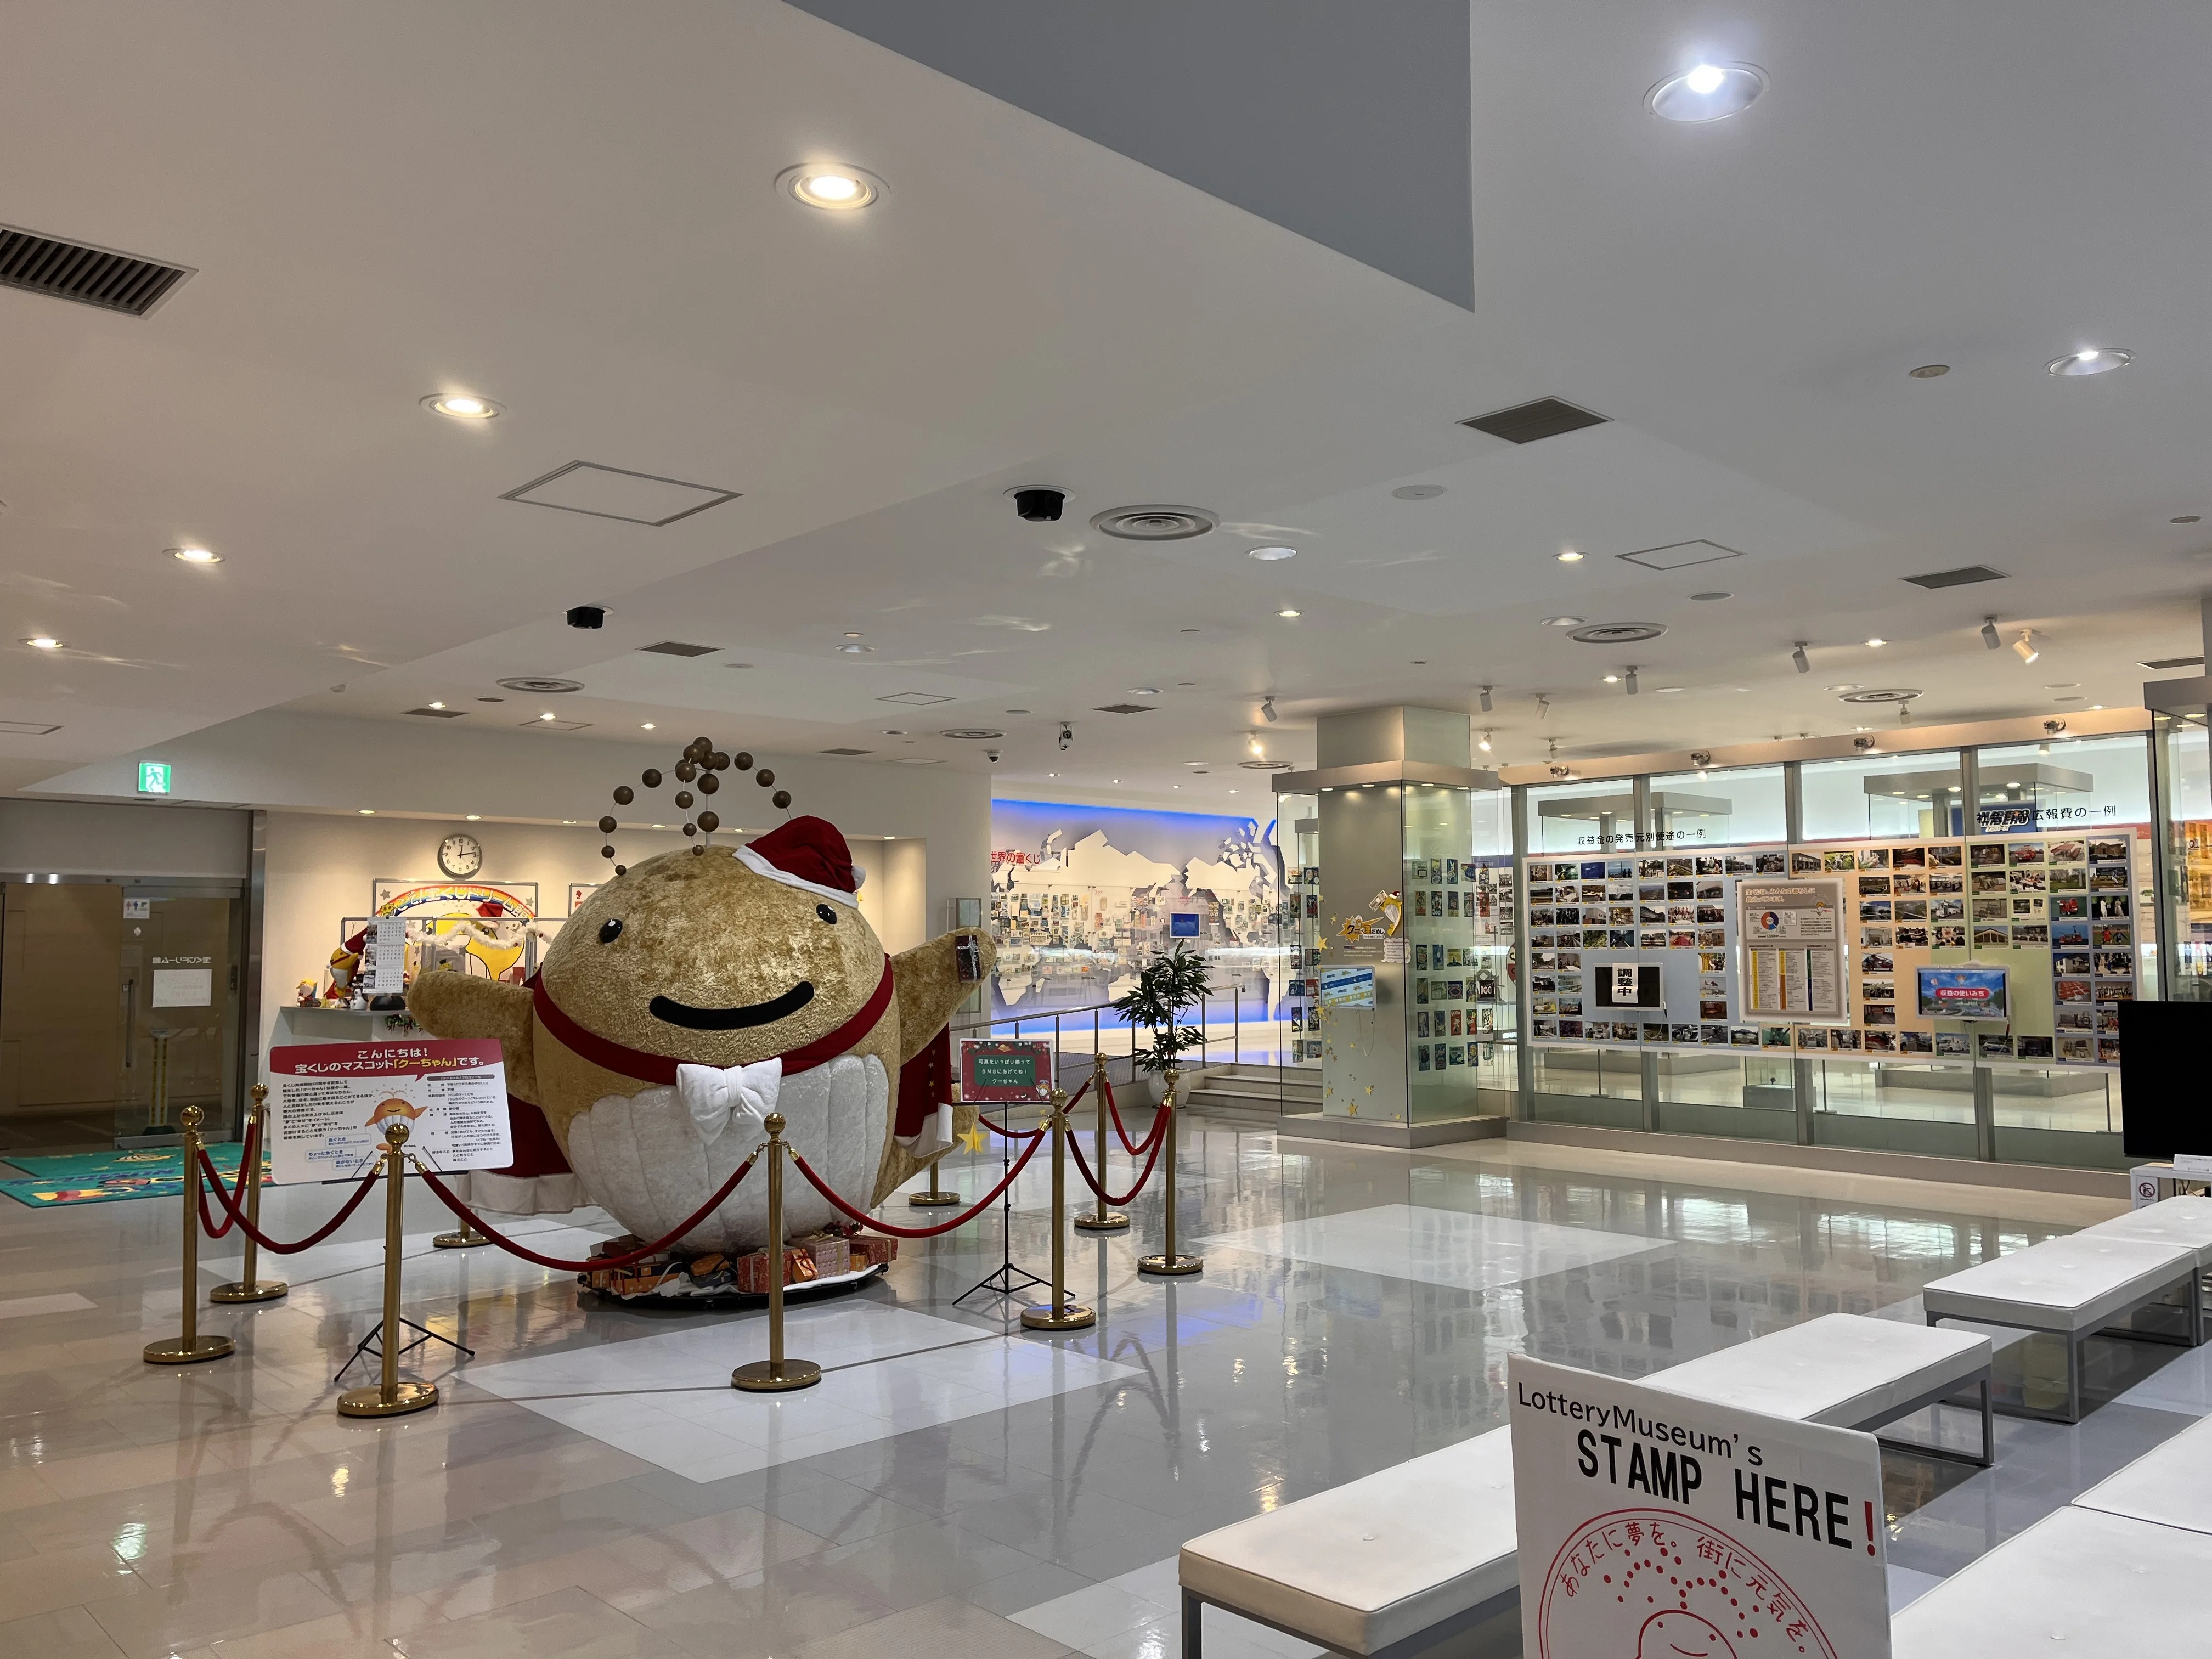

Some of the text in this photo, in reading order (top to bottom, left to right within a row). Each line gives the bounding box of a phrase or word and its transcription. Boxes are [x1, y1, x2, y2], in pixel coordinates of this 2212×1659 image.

[1577, 828, 1706, 845] 収益金の発売元別使途の一例
[991, 851, 1041, 864] 世界の富くじ
[393, 886, 531, 918] こそ！宝くじドリーム館
[1617, 968, 1633, 996] 調整中
[357, 1048, 428, 1059] こんにちは！
[295, 1057, 484, 1074] 宝くじのマスコット「クーちゃん」です。
[1577, 1429, 1876, 1557] STAMP HERE!
[1561, 1521, 1809, 1654] あなたに夢を。 街に元気を。
